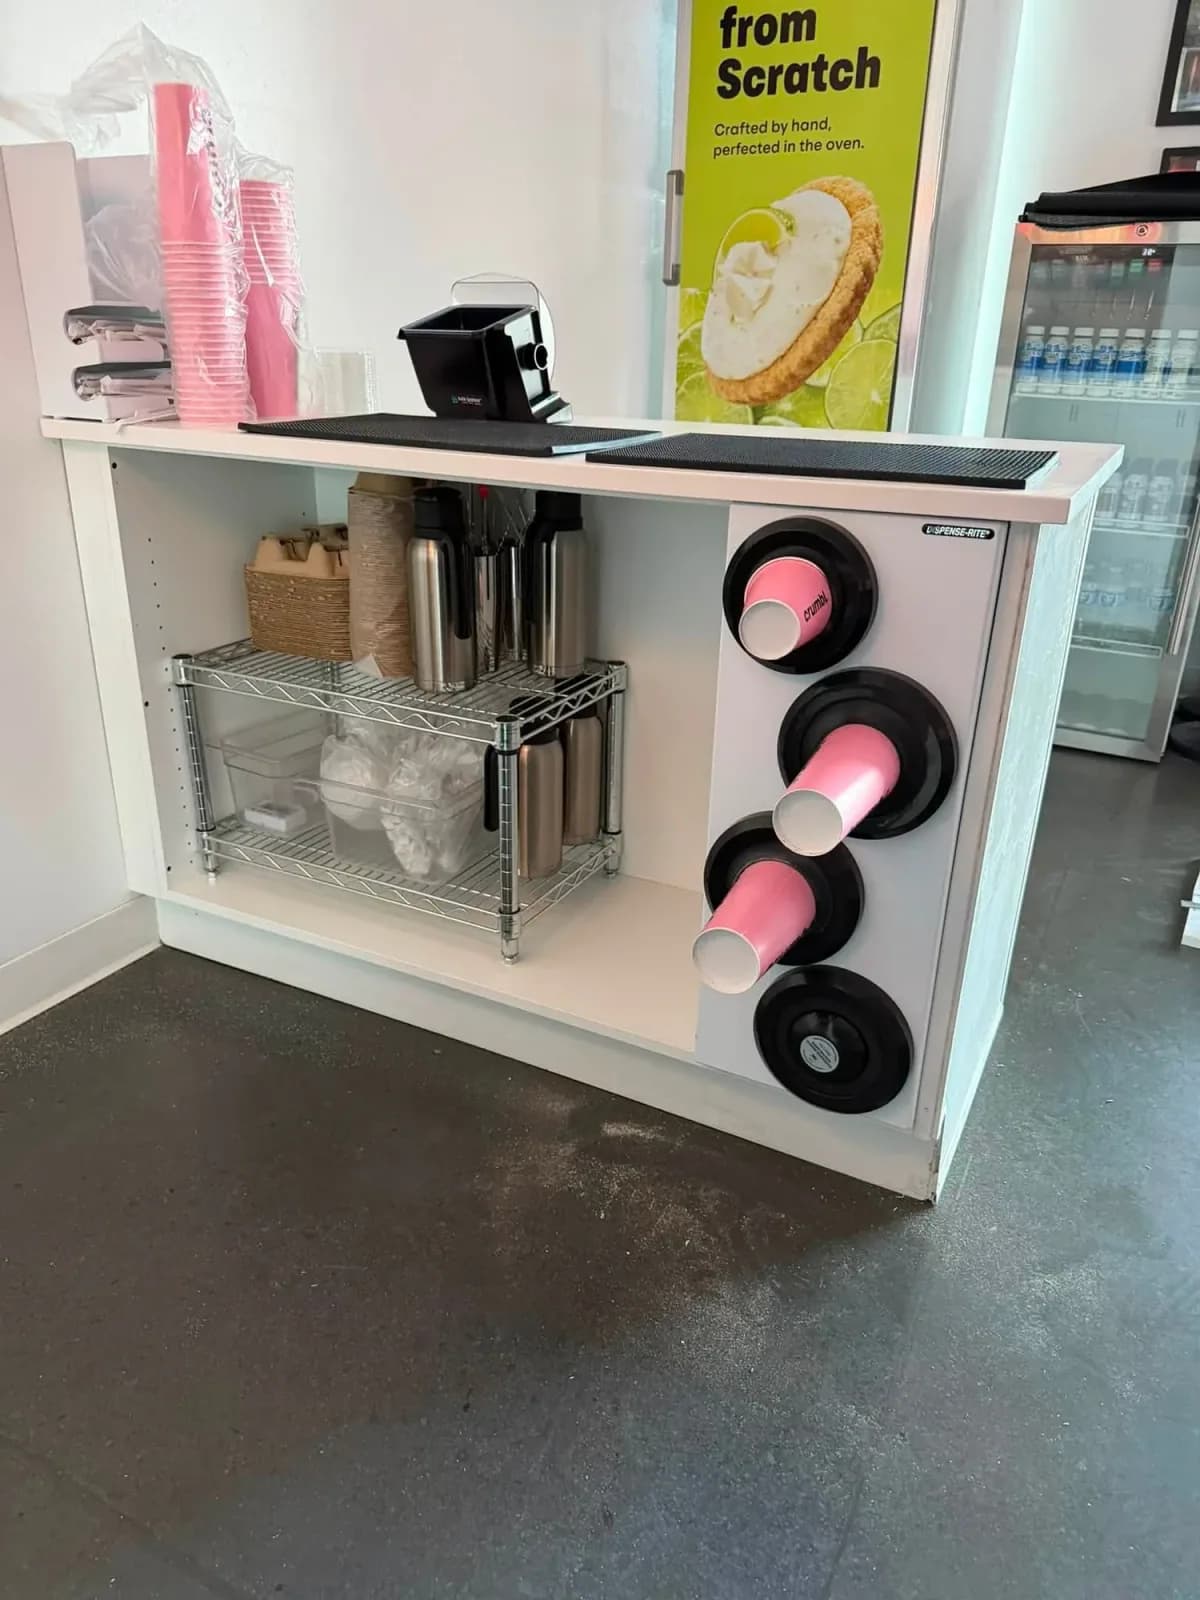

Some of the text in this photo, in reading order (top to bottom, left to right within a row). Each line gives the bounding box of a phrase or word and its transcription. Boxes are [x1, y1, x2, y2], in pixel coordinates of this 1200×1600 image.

[719, 5, 817, 49] from
[716, 46, 881, 100] Scratch
[714, 117, 832, 137] Crafted by hand,
[713, 137, 865, 158] perfected in the oven.
[804, 590, 828, 623] crumbl
